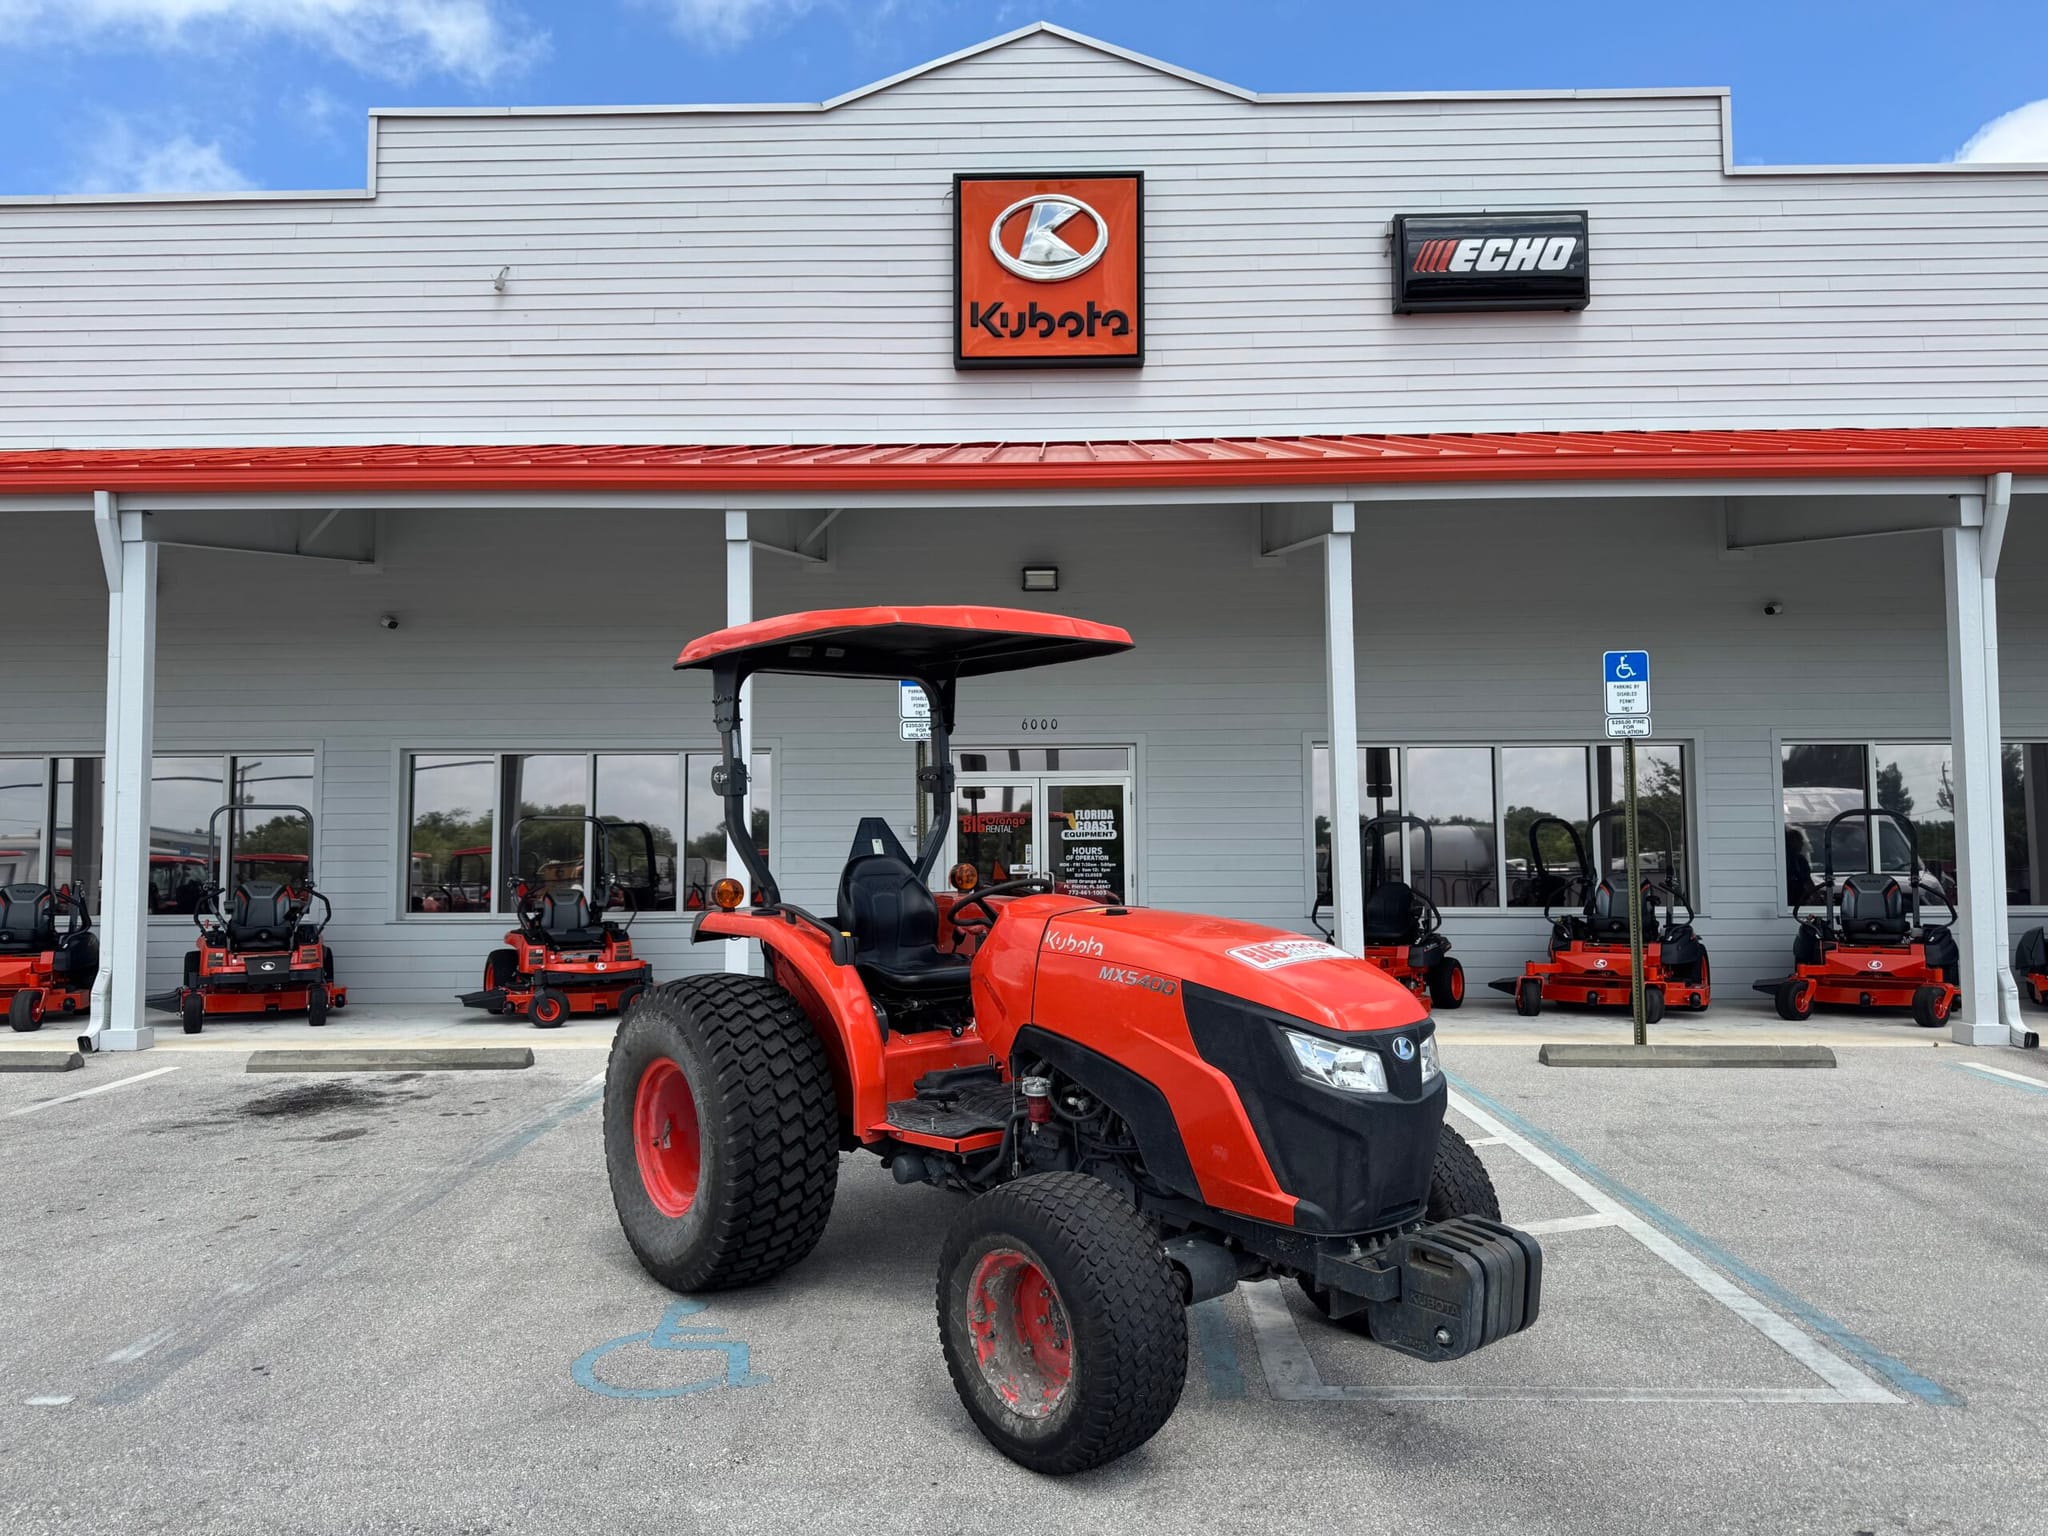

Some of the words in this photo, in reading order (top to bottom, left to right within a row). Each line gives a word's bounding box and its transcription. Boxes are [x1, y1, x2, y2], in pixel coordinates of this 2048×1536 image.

[1449, 237, 1577, 272] ECHO
[970, 301, 1129, 338] Kubota
[1021, 717, 1058, 730] 6000
[1075, 809, 1114, 820] FLORIDA
[963, 815, 985, 833] BIG
[985, 815, 1026, 828] Orange
[985, 825, 1013, 833] RENTAL
[1076, 821, 1114, 830] COAST
[1072, 847, 1103, 855] HOURS
[1045, 930, 1104, 956] Kubota
[1099, 966, 1177, 996] MX5400
